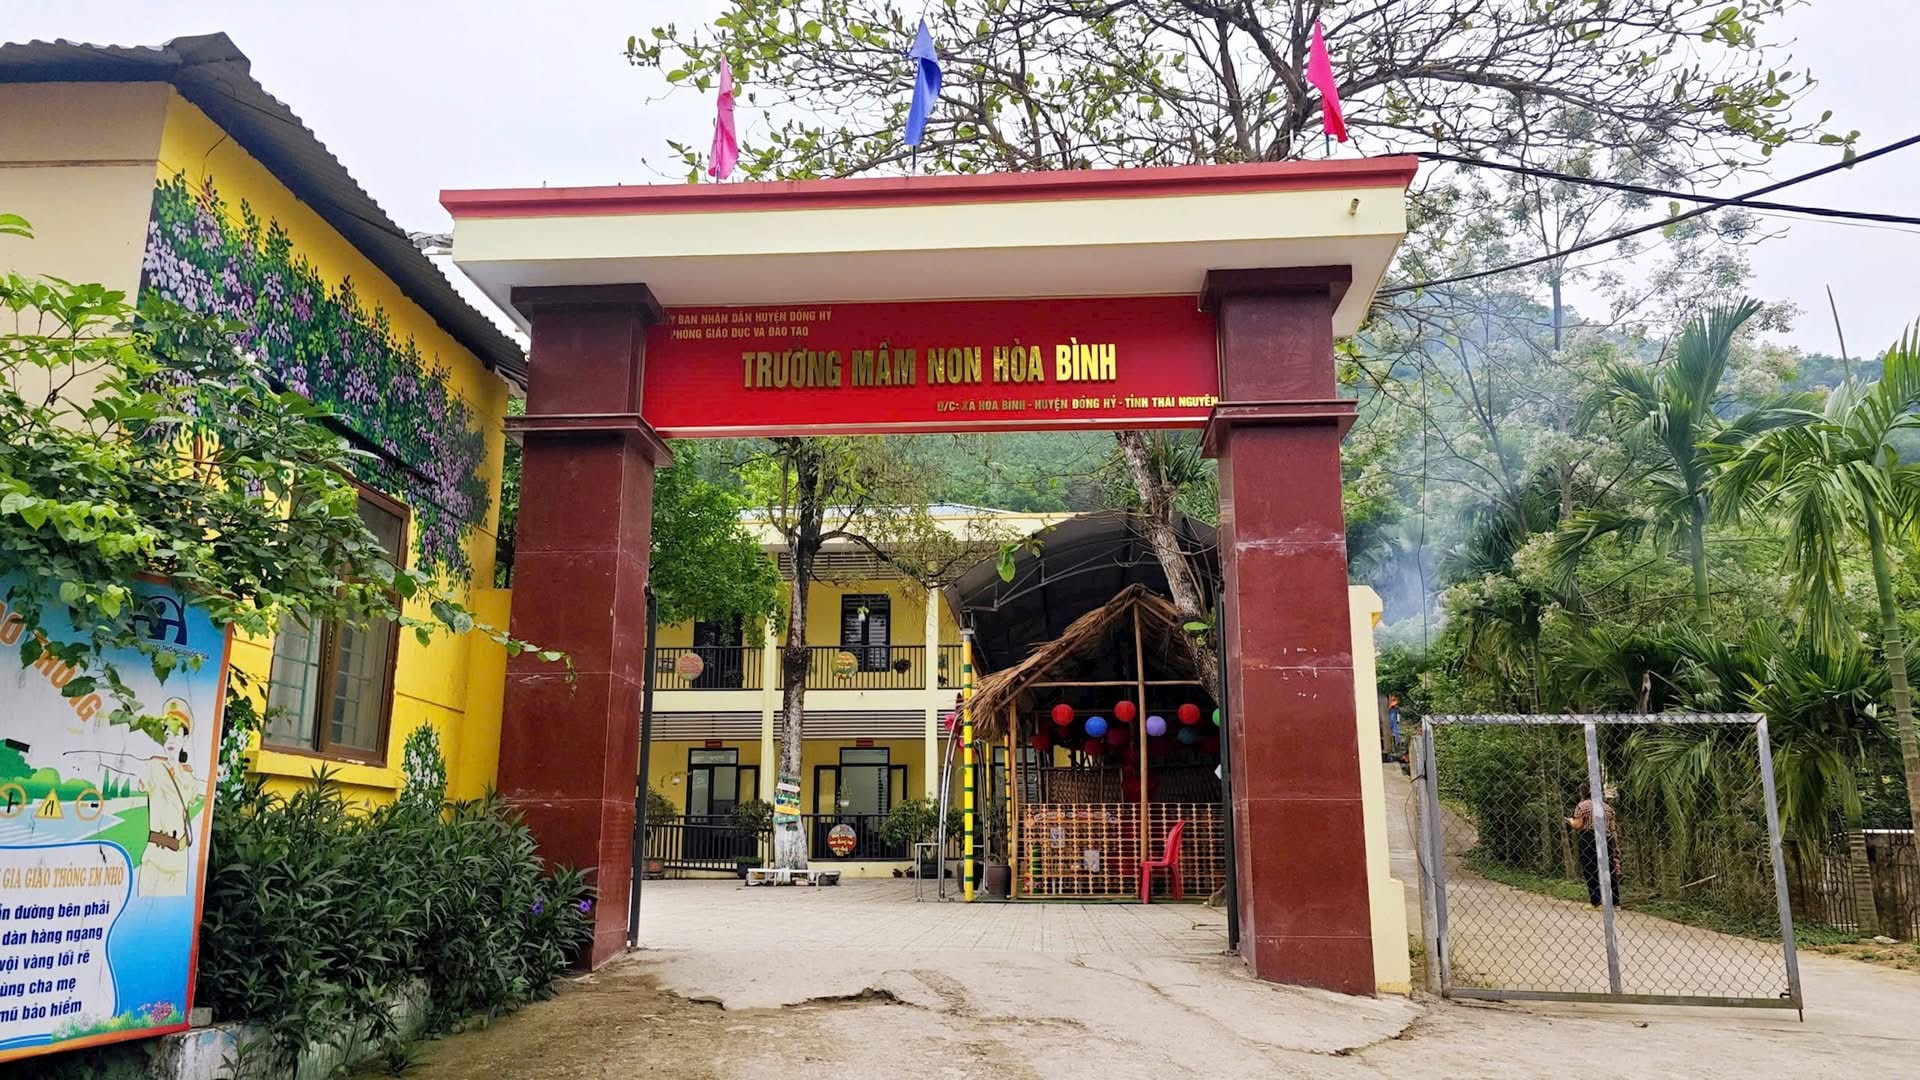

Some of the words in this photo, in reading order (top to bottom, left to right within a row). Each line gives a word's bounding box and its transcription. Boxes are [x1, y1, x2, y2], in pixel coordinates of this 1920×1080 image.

[678, 314, 698, 325] BAN
[701, 311, 729, 325] NHÂN
[731, 310, 752, 324] DÂN
[705, 326, 728, 339] GIÁO
[742, 345, 842, 388] TRƯỜNG
[927, 346, 982, 384] NON
[993, 338, 1045, 383] HÒA
[1055, 337, 1117, 382] BÌNH
[1034, 397, 1068, 413] HUYỆN
[1124, 393, 1149, 409] TỈNH
[1178, 393, 1219, 408] NGUYÊN
[2, 867, 21, 889] GIA
[88, 866, 103, 887] EM
[58, 902, 81, 918] bên
[84, 899, 110, 917] phải
[2, 930, 27, 946] dàn
[31, 928, 63, 944] hàng
[66, 927, 103, 943] ngang
[23, 953, 55, 970] vàng
[58, 949, 74, 966] lối
[77, 949, 90, 964] rẽ
[29, 979, 53, 994] cha
[56, 977, 76, 993] mẹ
[22, 1002, 47, 1021] bảo
[50, 996, 82, 1018] hiểm
